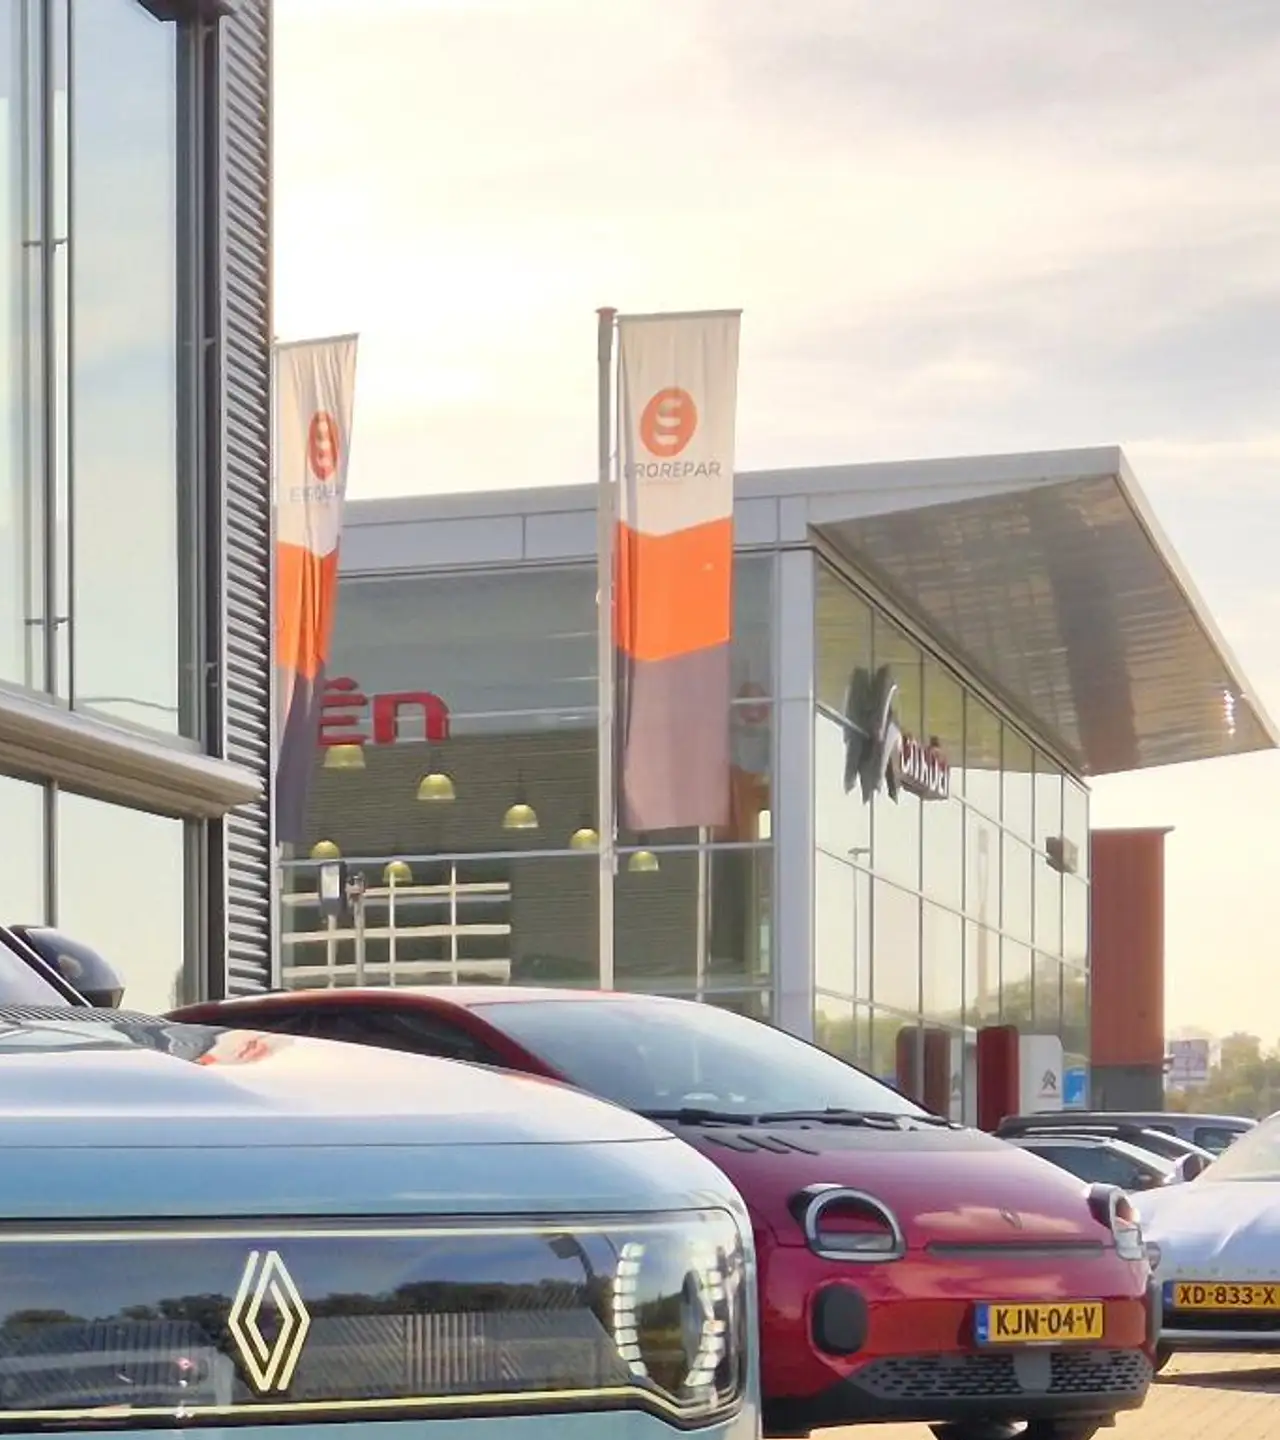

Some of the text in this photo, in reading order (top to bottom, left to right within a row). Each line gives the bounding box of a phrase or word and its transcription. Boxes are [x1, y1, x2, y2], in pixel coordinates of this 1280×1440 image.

[634, 460, 722, 478] ROREPAR
[1180, 1285, 1275, 1305] XD-833-X
[995, 1306, 1096, 1336] KJN-04-V
